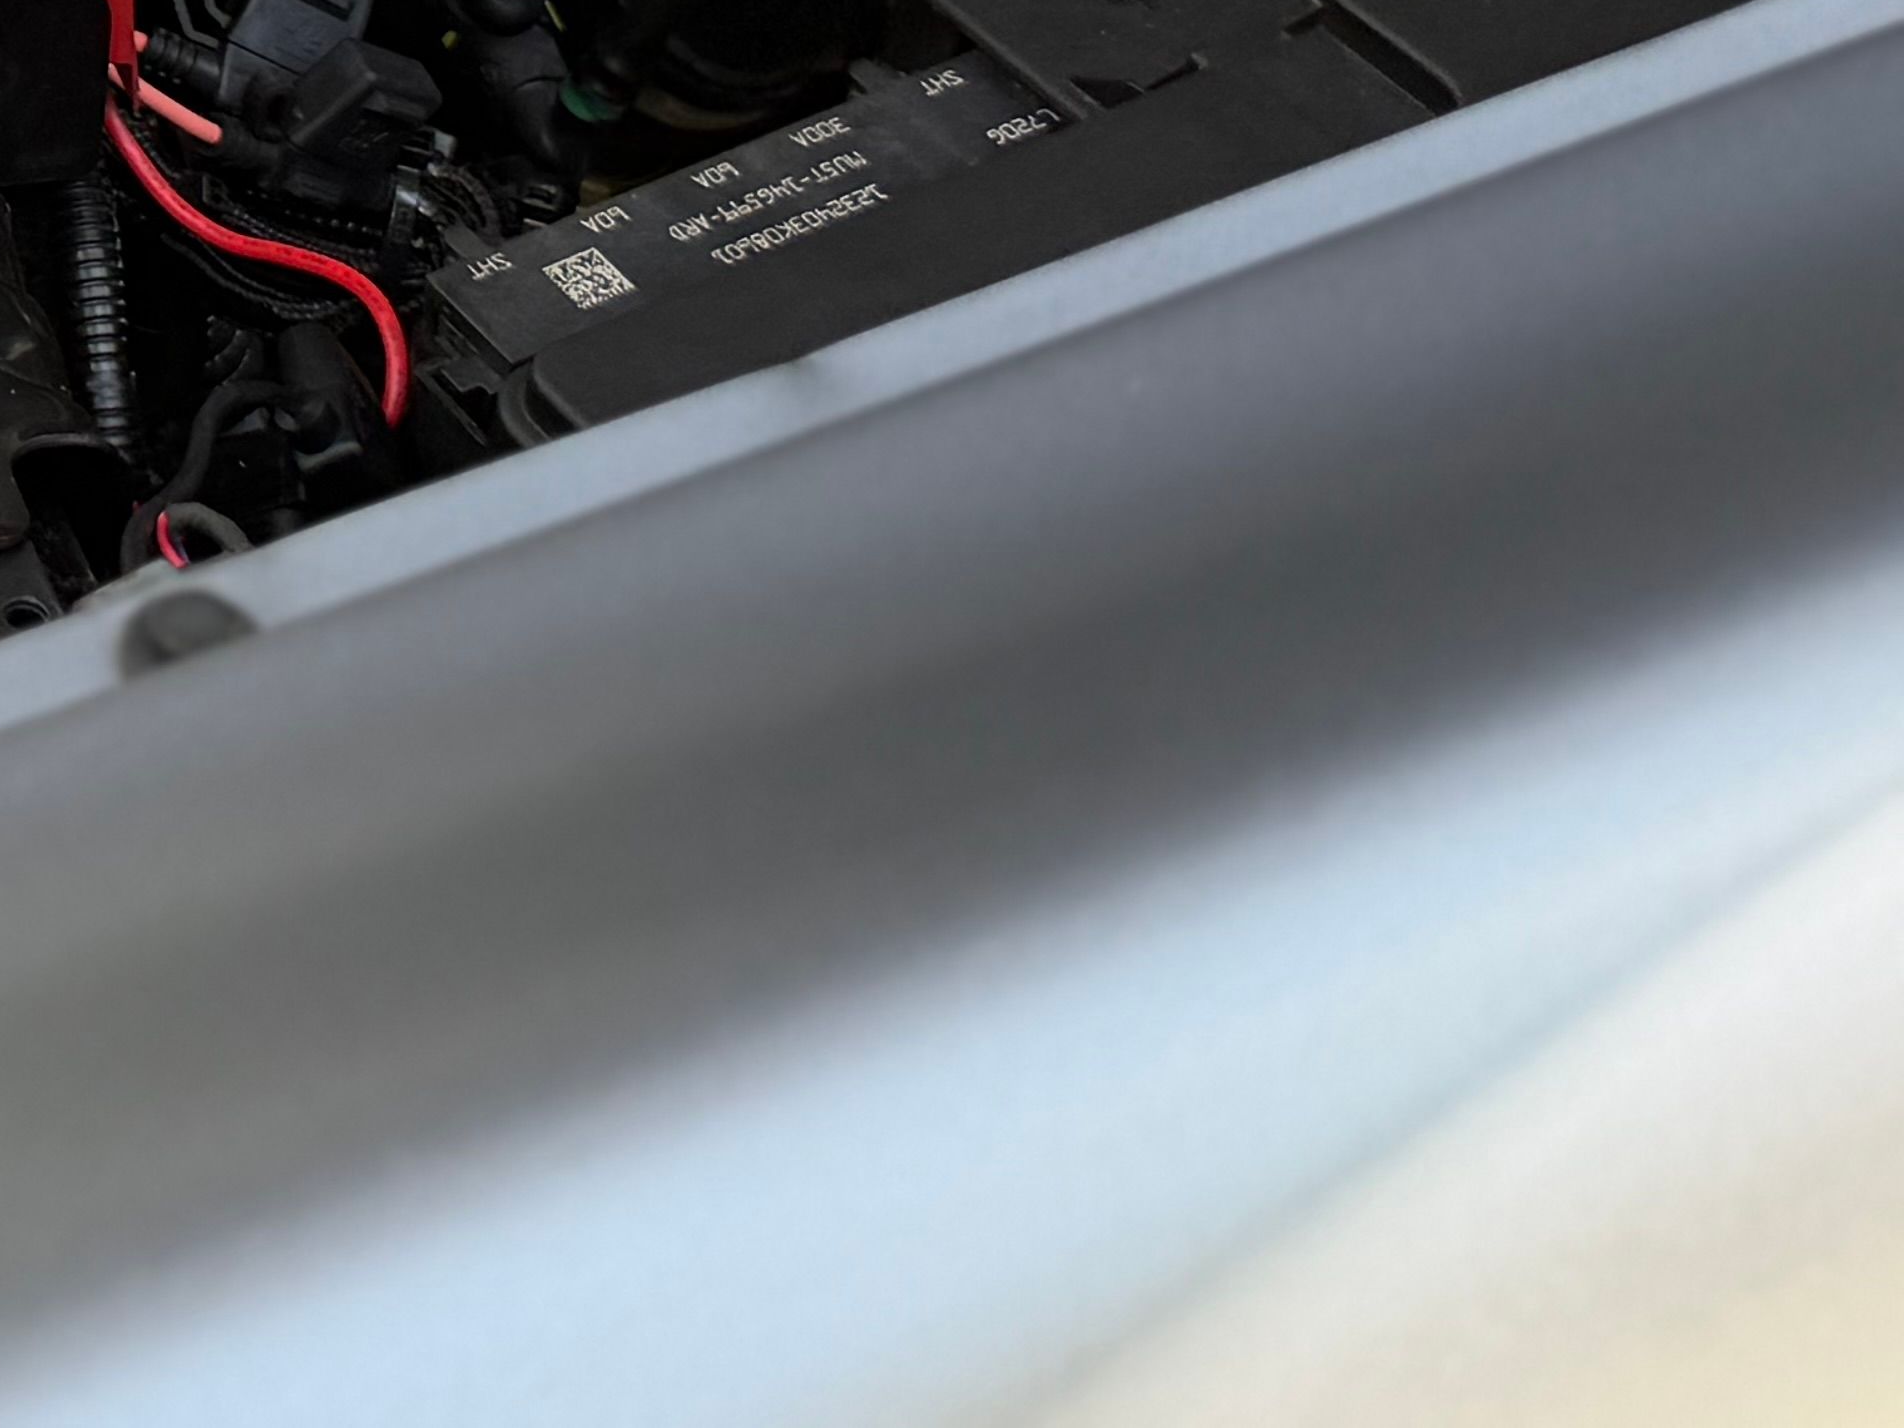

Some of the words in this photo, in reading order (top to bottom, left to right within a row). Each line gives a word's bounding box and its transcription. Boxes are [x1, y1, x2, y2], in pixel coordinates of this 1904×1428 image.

[789, 117, 851, 147] 300A
[690, 161, 740, 190] 60A
[579, 204, 632, 234] 60A
